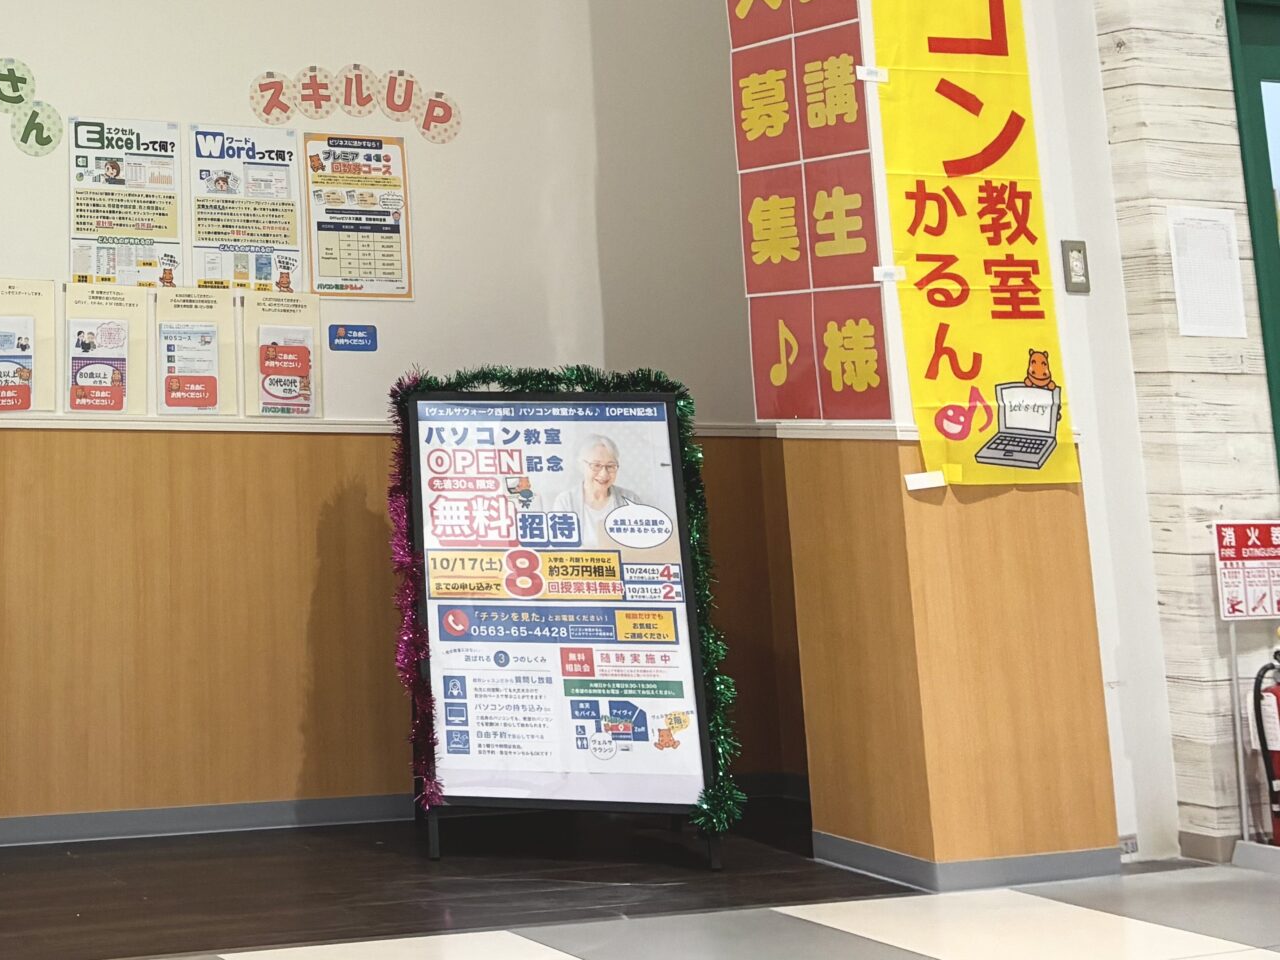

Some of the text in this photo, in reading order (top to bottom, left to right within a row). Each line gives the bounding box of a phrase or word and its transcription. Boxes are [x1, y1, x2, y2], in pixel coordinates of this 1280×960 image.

[259, 74, 453, 132] スキルUP
[105, 127, 136, 137] エクセル
[225, 136, 252, 145] ワード
[322, 150, 359, 162] プレミア
[424, 426, 562, 446] パソコン教室
[426, 448, 564, 475] OPEN 記念
[428, 494, 579, 541] 無料 招待
[430, 557, 504, 573] 10/17(土)
[547, 564, 617, 578] 約3万円相当
[625, 567, 660, 576] 10/24(土)
[504, 549, 544, 598] 8
[435, 582, 501, 592] までの申し込みで
[627, 586, 662, 595] 10/31(土)
[470, 625, 568, 638] 0563-65-4428
